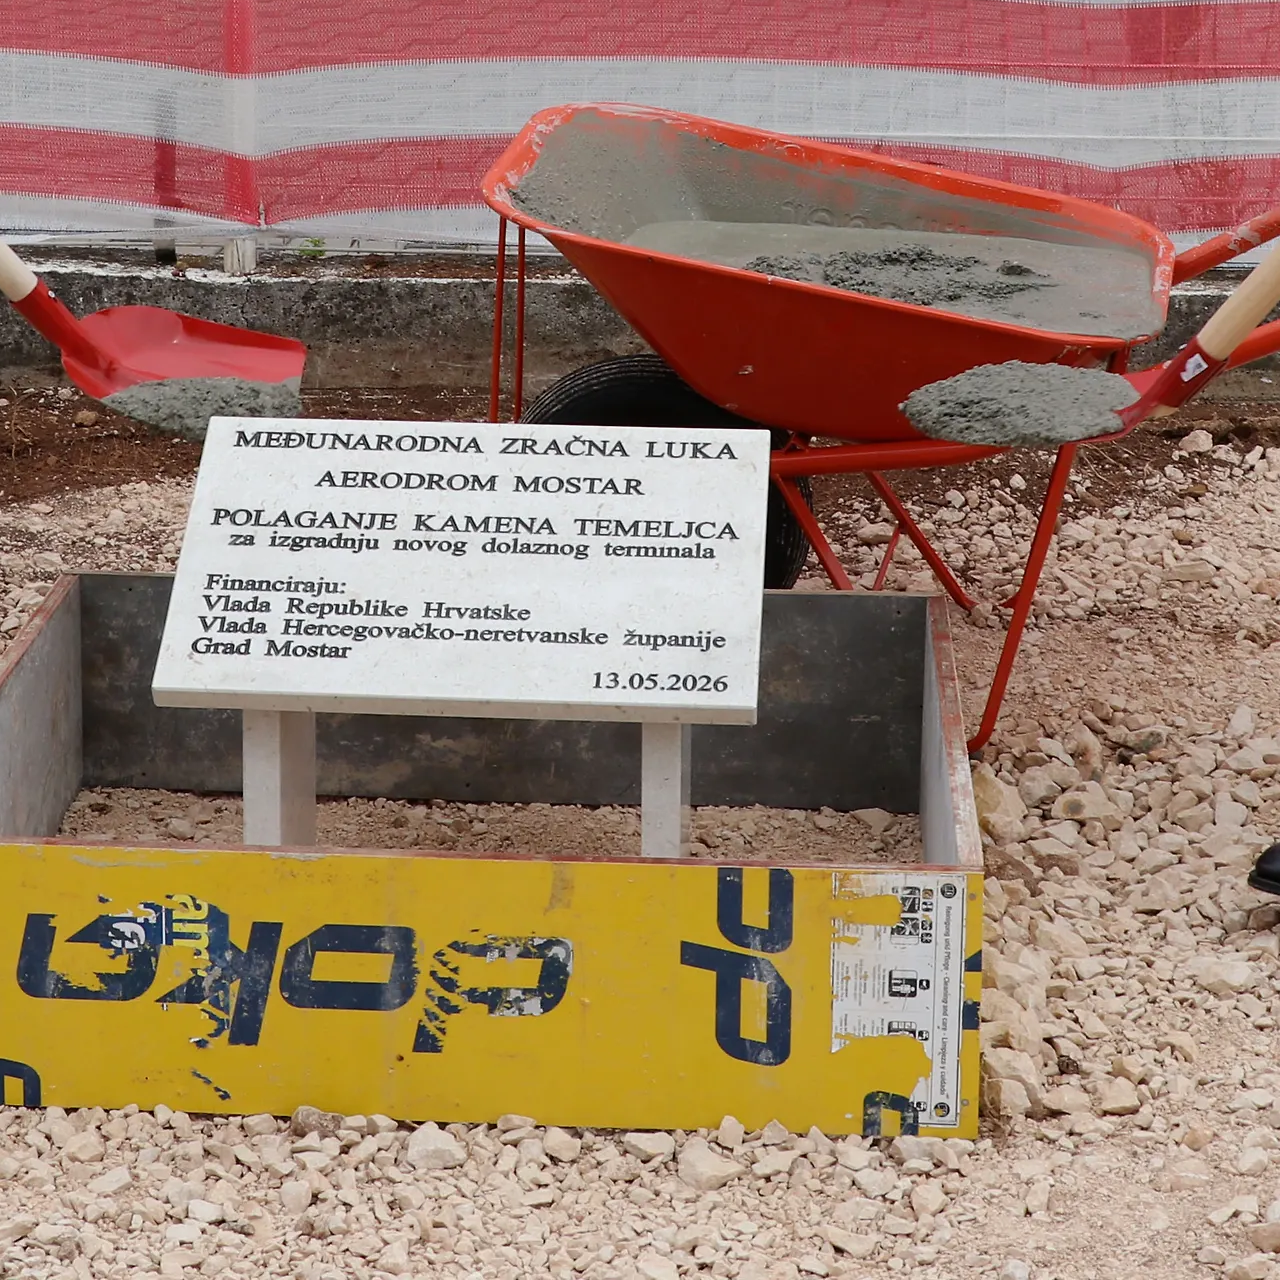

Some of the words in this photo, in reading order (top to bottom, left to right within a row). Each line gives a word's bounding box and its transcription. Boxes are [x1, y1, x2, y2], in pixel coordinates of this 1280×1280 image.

[233, 430, 484, 453] MEĐUNARODNA
[498, 435, 630, 458] ZRAČNA
[645, 440, 738, 460] LUKA
[314, 470, 498, 492] AERODROM
[512, 475, 646, 496] MOSTAR
[210, 508, 398, 530] POLAGANJE
[412, 513, 557, 535] KAMENA
[574, 519, 740, 540] TEMELJCA
[228, 533, 256, 546] za
[269, 530, 380, 554] izgradnju
[392, 538, 468, 557] novog
[481, 537, 590, 560] dolaznog
[604, 542, 716, 560] terminala
[204, 573, 347, 598] Financiraju:
[202, 594, 271, 614] Vlada
[285, 597, 408, 619] Republike
[421, 601, 531, 621] Hrvatske
[198, 616, 267, 634] Vlada
[280, 618, 609, 646] Hercegovačko-neretvanske
[622, 629, 727, 652] županije
[191, 637, 251, 656] Grad
[264, 639, 353, 659] Mostar
[592, 671, 729, 693] 13.05.2026
